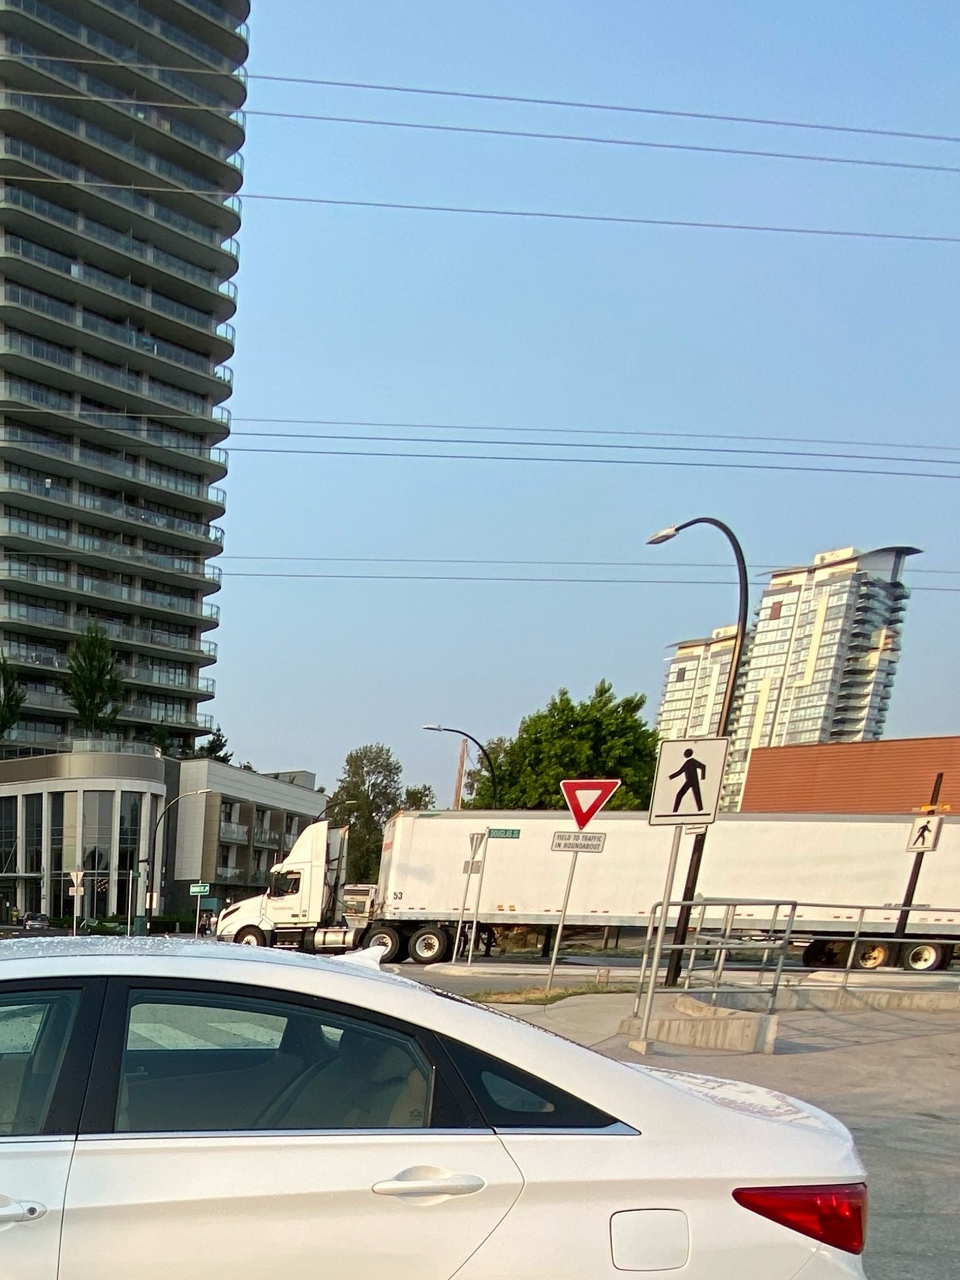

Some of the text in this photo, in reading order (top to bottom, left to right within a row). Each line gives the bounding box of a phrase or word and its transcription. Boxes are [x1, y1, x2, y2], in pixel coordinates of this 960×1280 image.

[491, 830, 513, 838] DOUGLAS
[563, 842, 601, 850] ROUNDABOUT
[393, 891, 403, 900] 53
